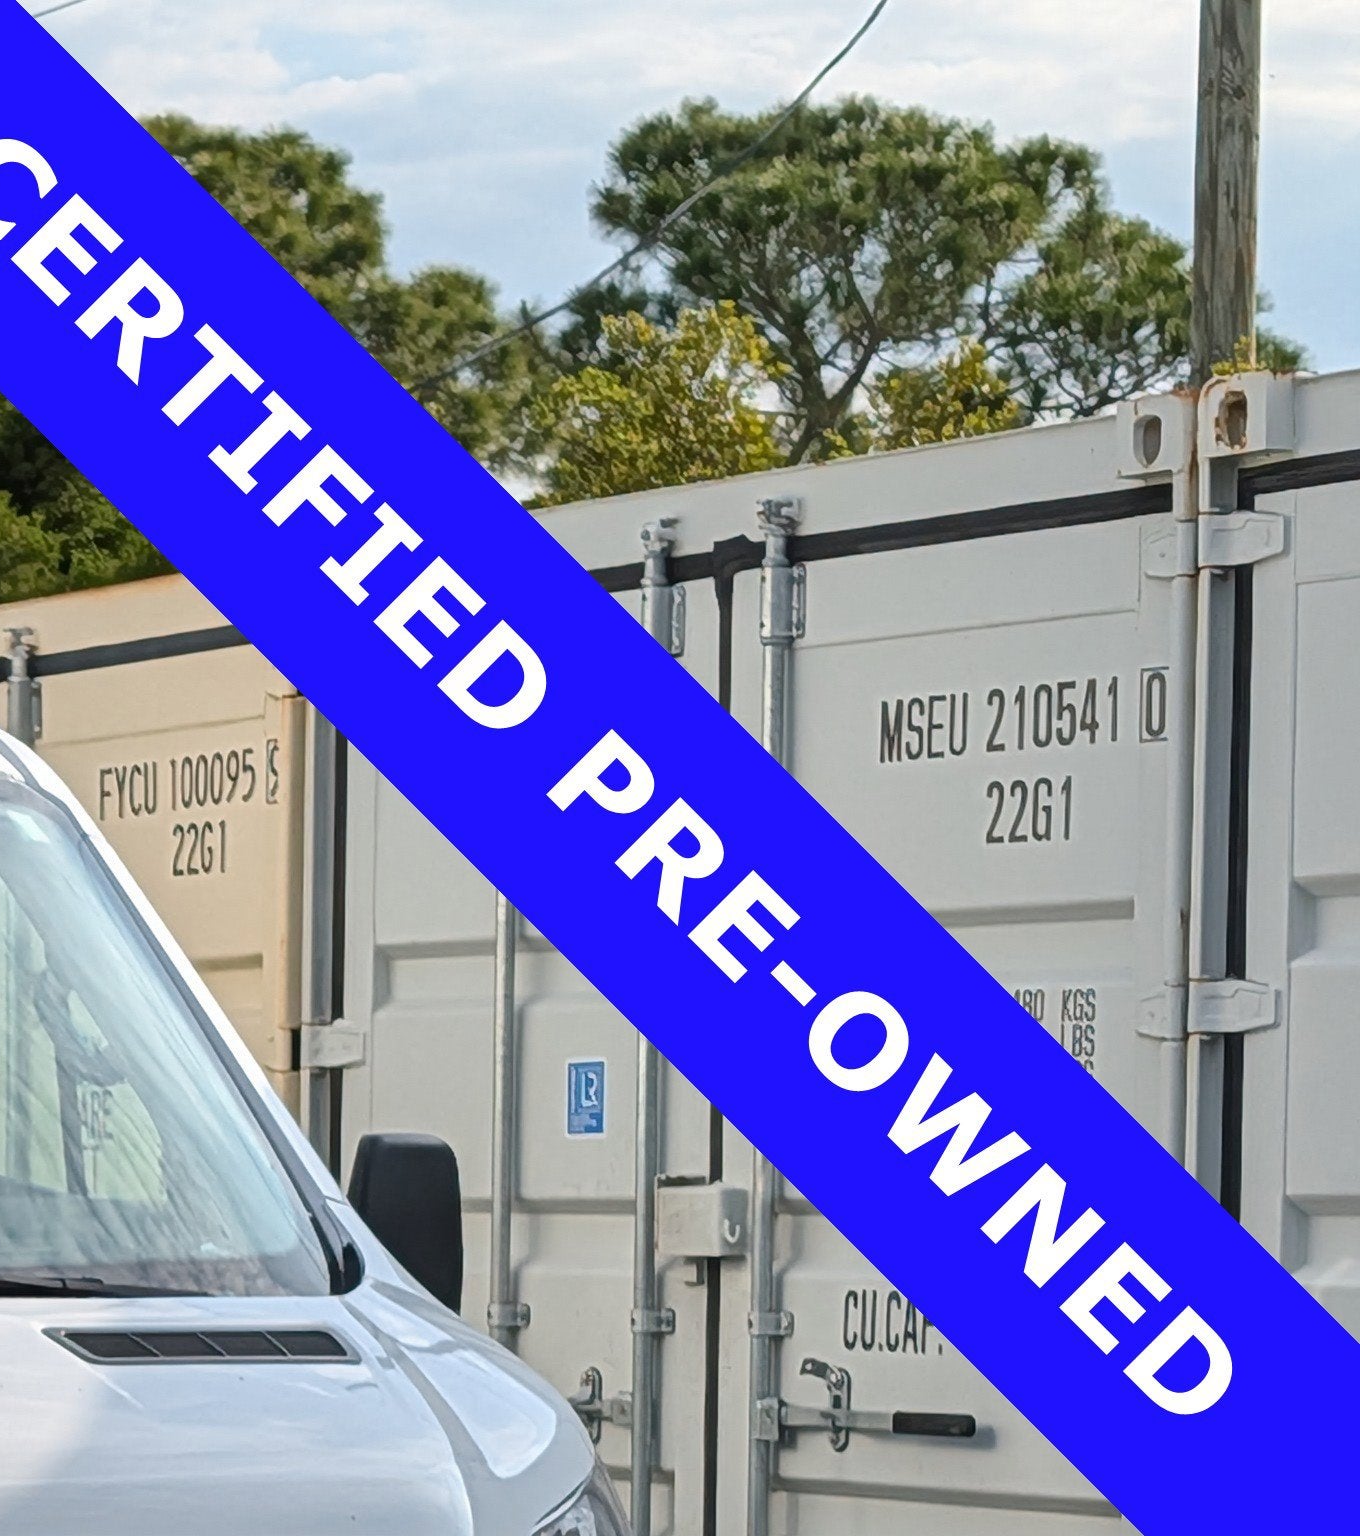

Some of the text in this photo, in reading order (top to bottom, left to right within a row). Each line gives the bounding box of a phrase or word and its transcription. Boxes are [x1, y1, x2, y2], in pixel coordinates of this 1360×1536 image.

[880, 692, 969, 763] MSEU
[986, 676, 1118, 752] 210541
[99, 761, 157, 820] FYCU
[170, 748, 256, 811] 100095
[986, 775, 1072, 843] 22G1
[172, 820, 226, 876] 22G1
[1014, 988, 1095, 1022] 80 KGS
